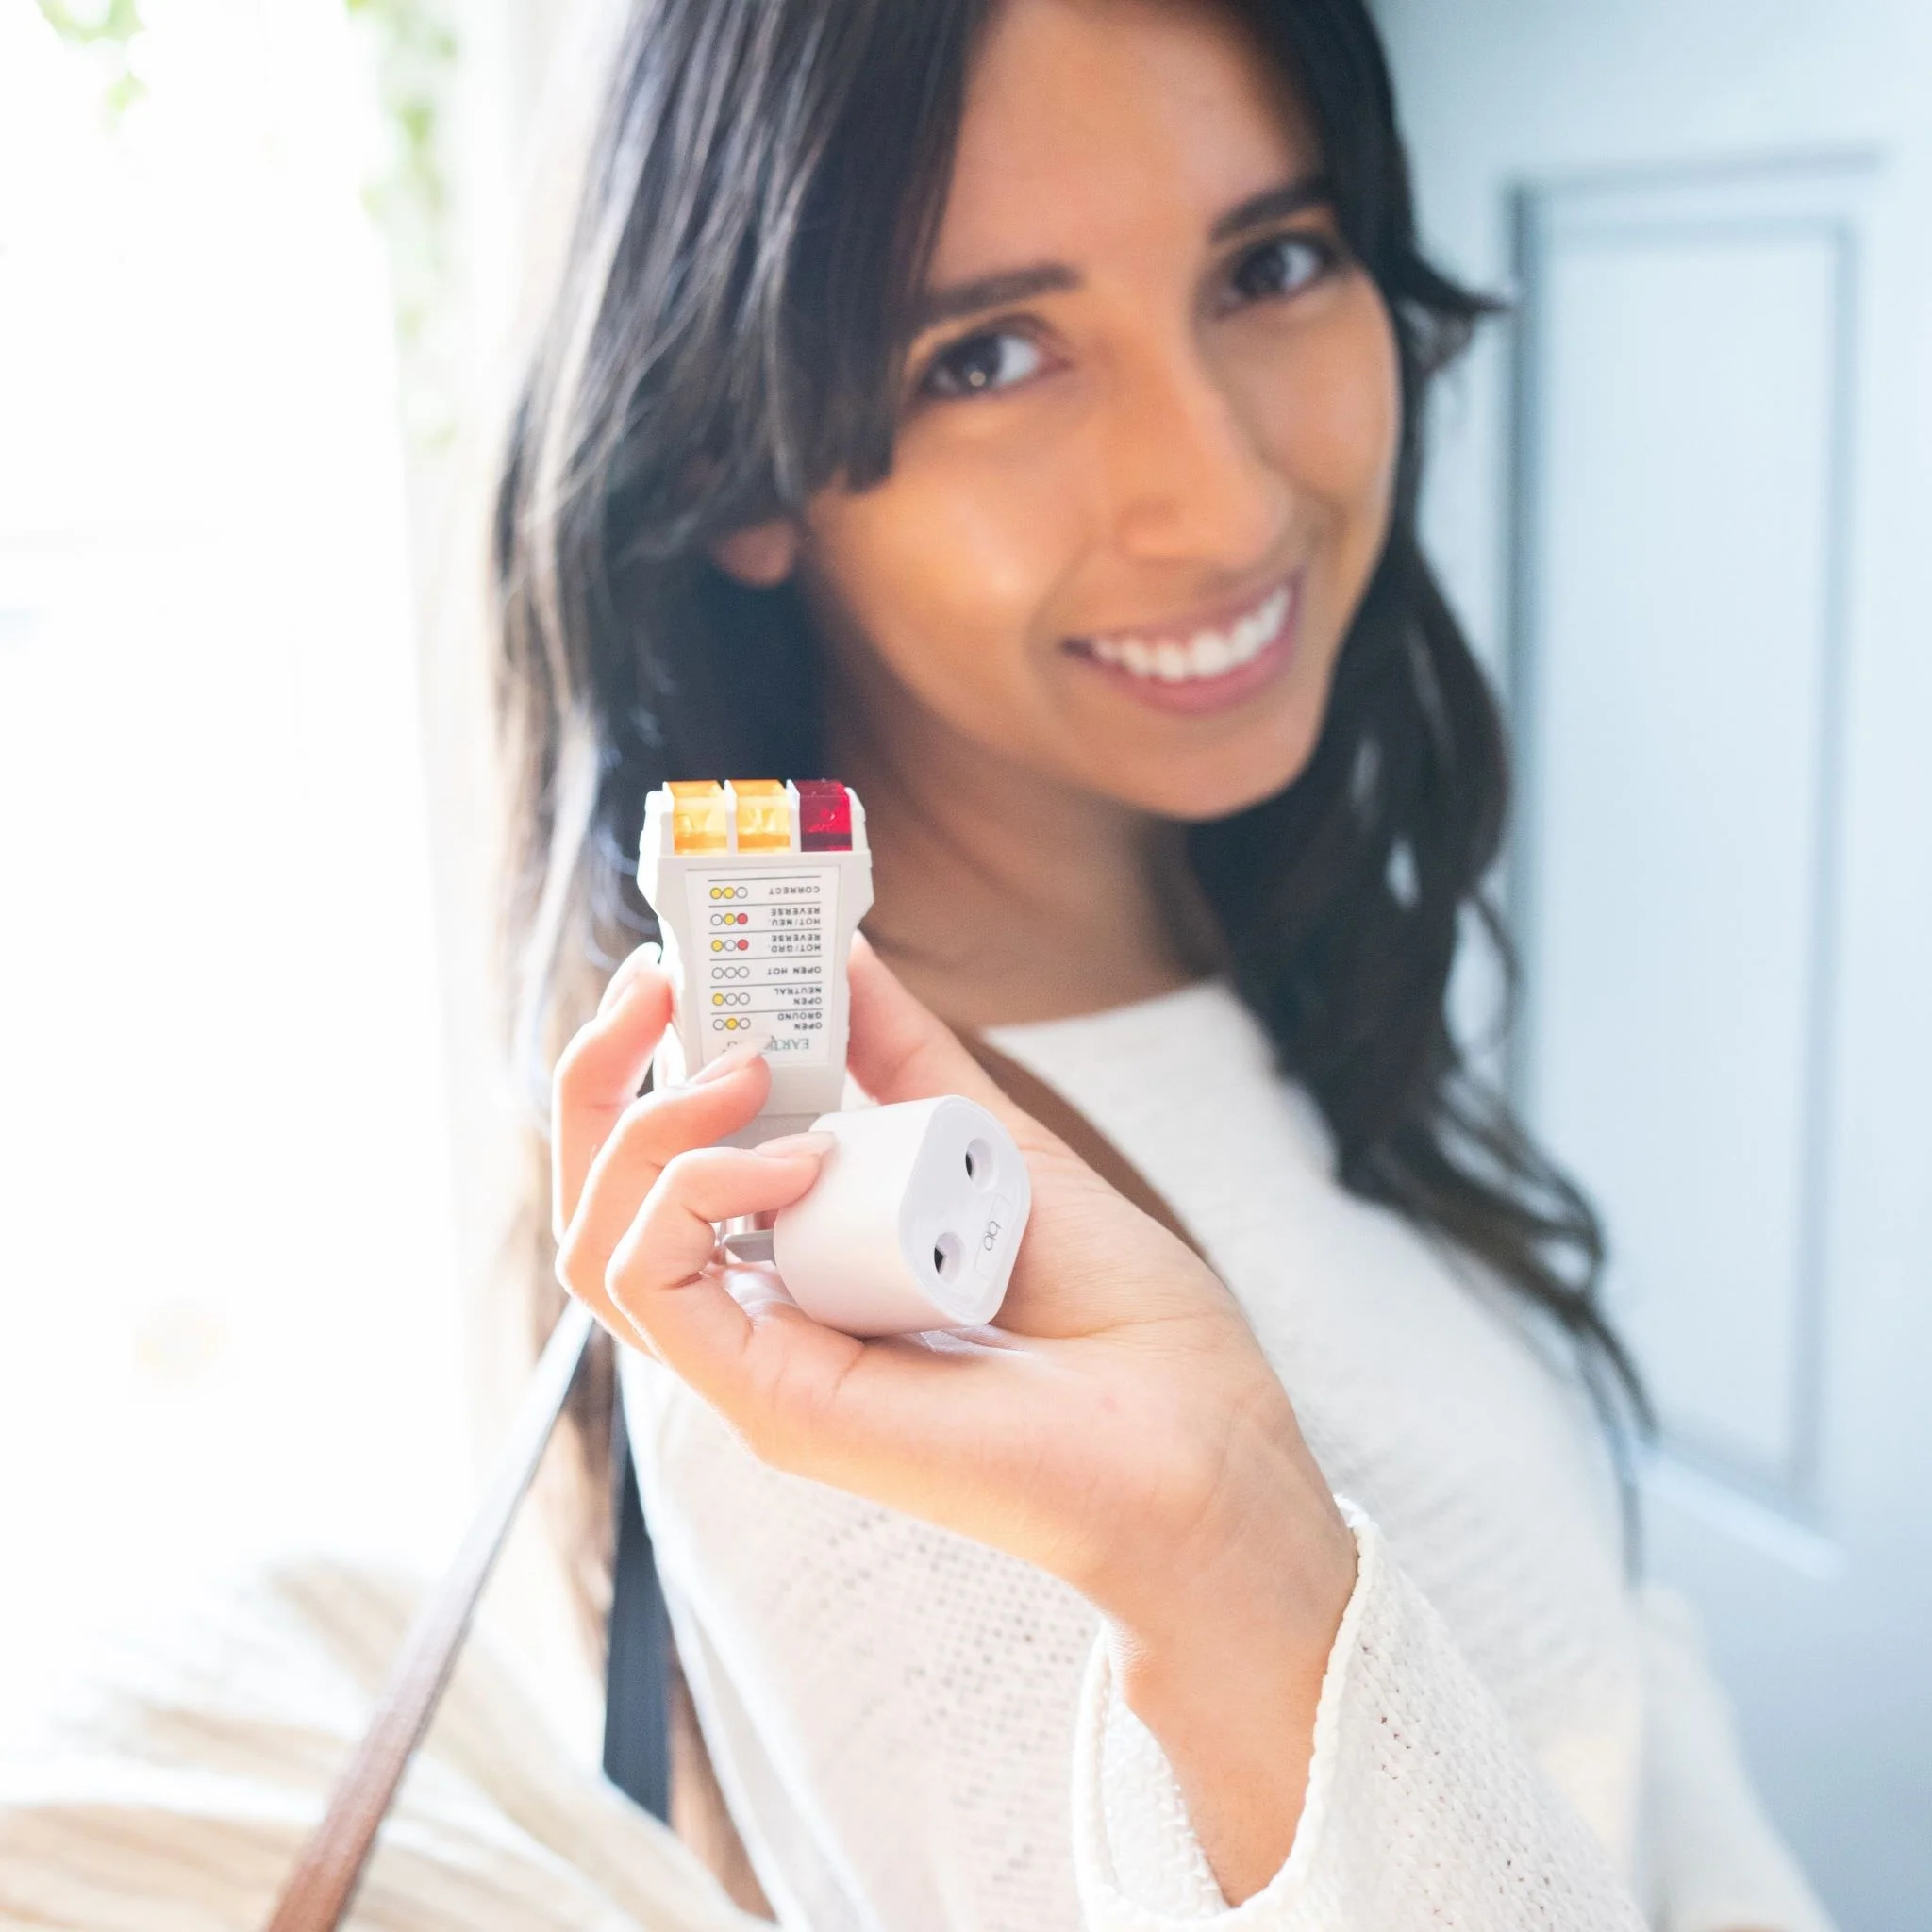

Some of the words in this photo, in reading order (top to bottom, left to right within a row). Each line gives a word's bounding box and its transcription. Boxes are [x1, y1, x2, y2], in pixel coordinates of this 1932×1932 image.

[769, 886, 821, 895] CORRECT
[771, 907, 821, 917] REVERSE
[771, 934, 821, 943] REVERSE
[767, 966, 788, 975] HOT
[792, 966, 822, 974] OPEN
[774, 987, 822, 995] NEUTRAL
[793, 996, 822, 1005] OPEN
[777, 1011, 822, 1021] GROUND
[794, 1022, 823, 1030] OPEN
